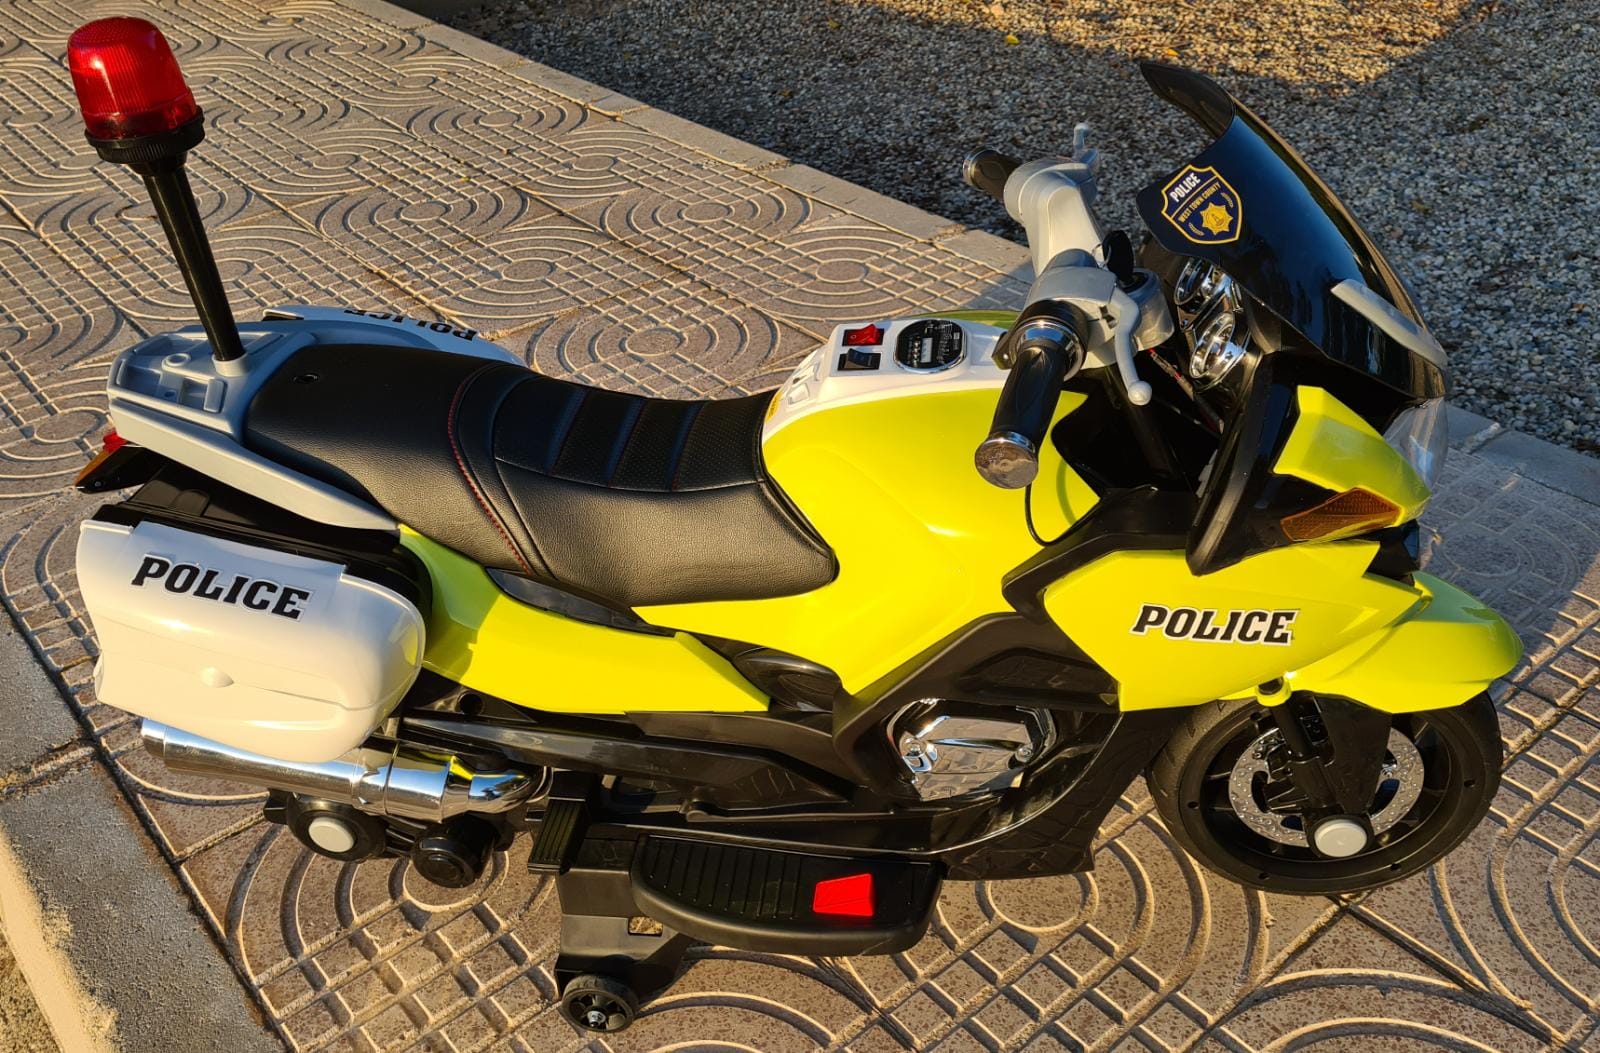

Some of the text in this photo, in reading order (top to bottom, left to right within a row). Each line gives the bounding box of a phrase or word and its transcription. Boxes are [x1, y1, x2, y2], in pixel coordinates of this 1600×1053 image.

[1169, 172, 1201, 202] POLICE
[1178, 181, 1221, 223] WEST TOWN COUNTY
[130, 555, 311, 620] POLICE
[1131, 603, 1297, 645] POLICE
